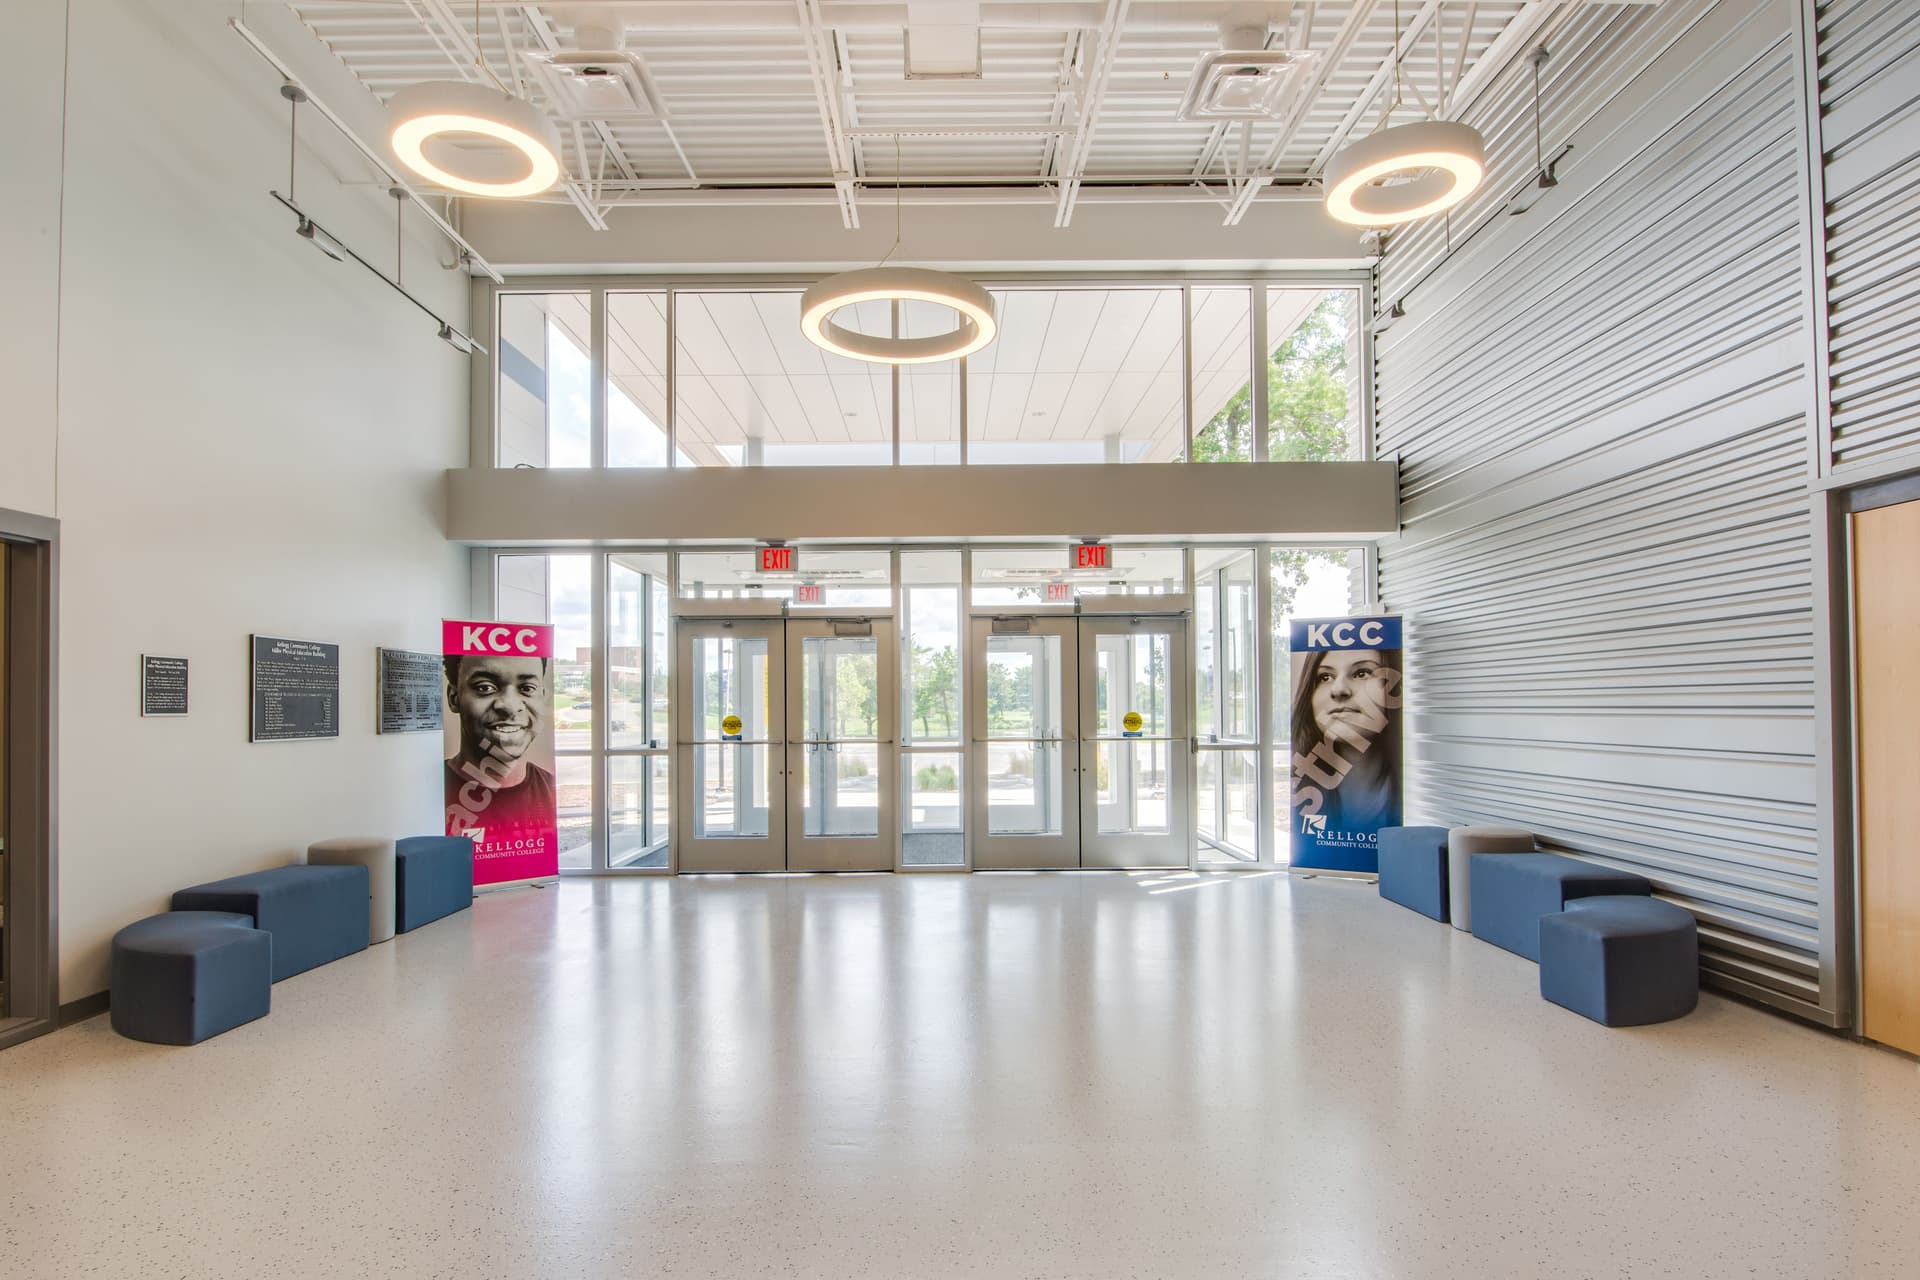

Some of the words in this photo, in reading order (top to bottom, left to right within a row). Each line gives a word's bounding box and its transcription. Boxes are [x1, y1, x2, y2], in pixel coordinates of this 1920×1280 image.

[763, 548, 791, 570] EXIT
[1078, 546, 1107, 568] EXIT
[799, 586, 820, 602] EXIT
[1047, 584, 1070, 601] EXIT
[462, 626, 538, 654] KCC
[1307, 621, 1384, 648] KCC
[1316, 830, 1377, 843] KELLOG
[1316, 840, 1357, 848] COMMUNITY
[475, 837, 545, 853] KELLOGG
[475, 850, 516, 860] COMMUNITY
[517, 848, 545, 856] COLLEGE
